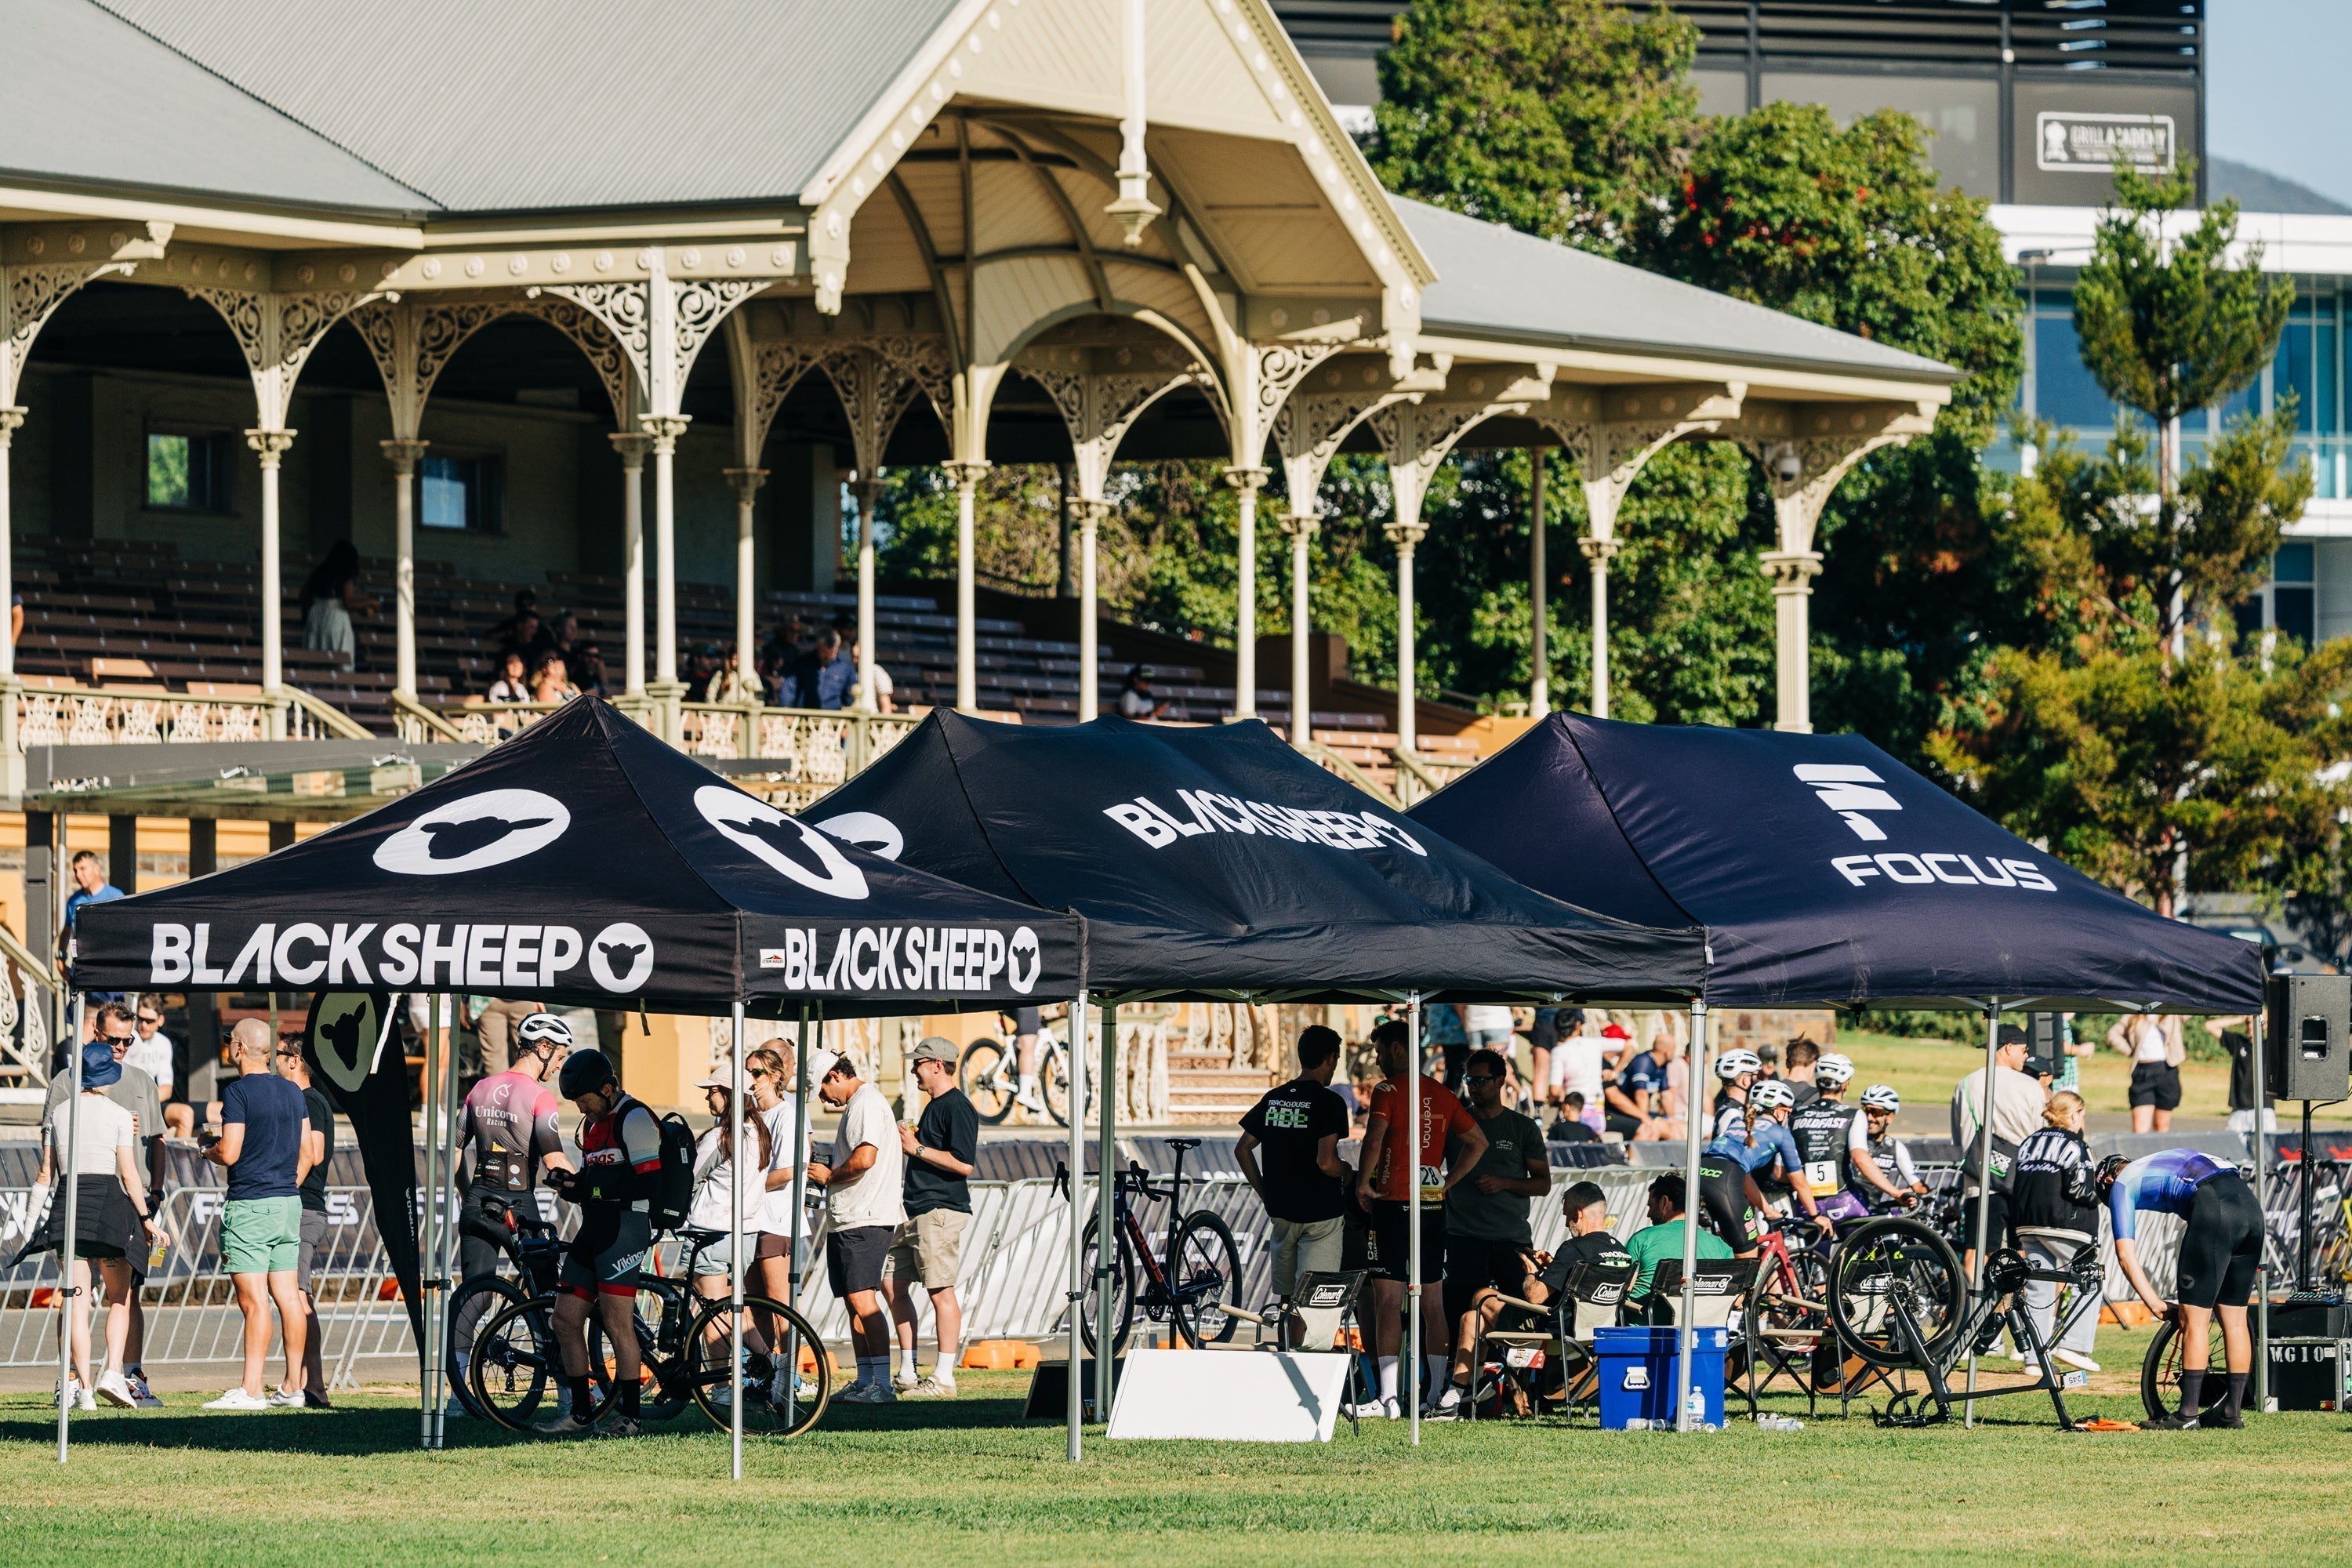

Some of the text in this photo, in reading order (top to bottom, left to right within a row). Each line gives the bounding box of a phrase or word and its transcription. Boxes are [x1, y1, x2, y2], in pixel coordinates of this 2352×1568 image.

[1831, 852, 2058, 892] FOCUS
[1268, 1099, 1312, 1109] TRACKHOUSE
[475, 1105, 518, 1123] Unicorn
[486, 1117, 507, 1127] RACING
[1793, 1118, 1849, 1131] HOLDFAST
[1421, 1166, 1439, 1185] 28
[1817, 1164, 1825, 1181] 5
[612, 1250, 645, 1272] Vikings
[1940, 1291, 1999, 1380] MERIDA
[2068, 1374, 2082, 1385] 245
